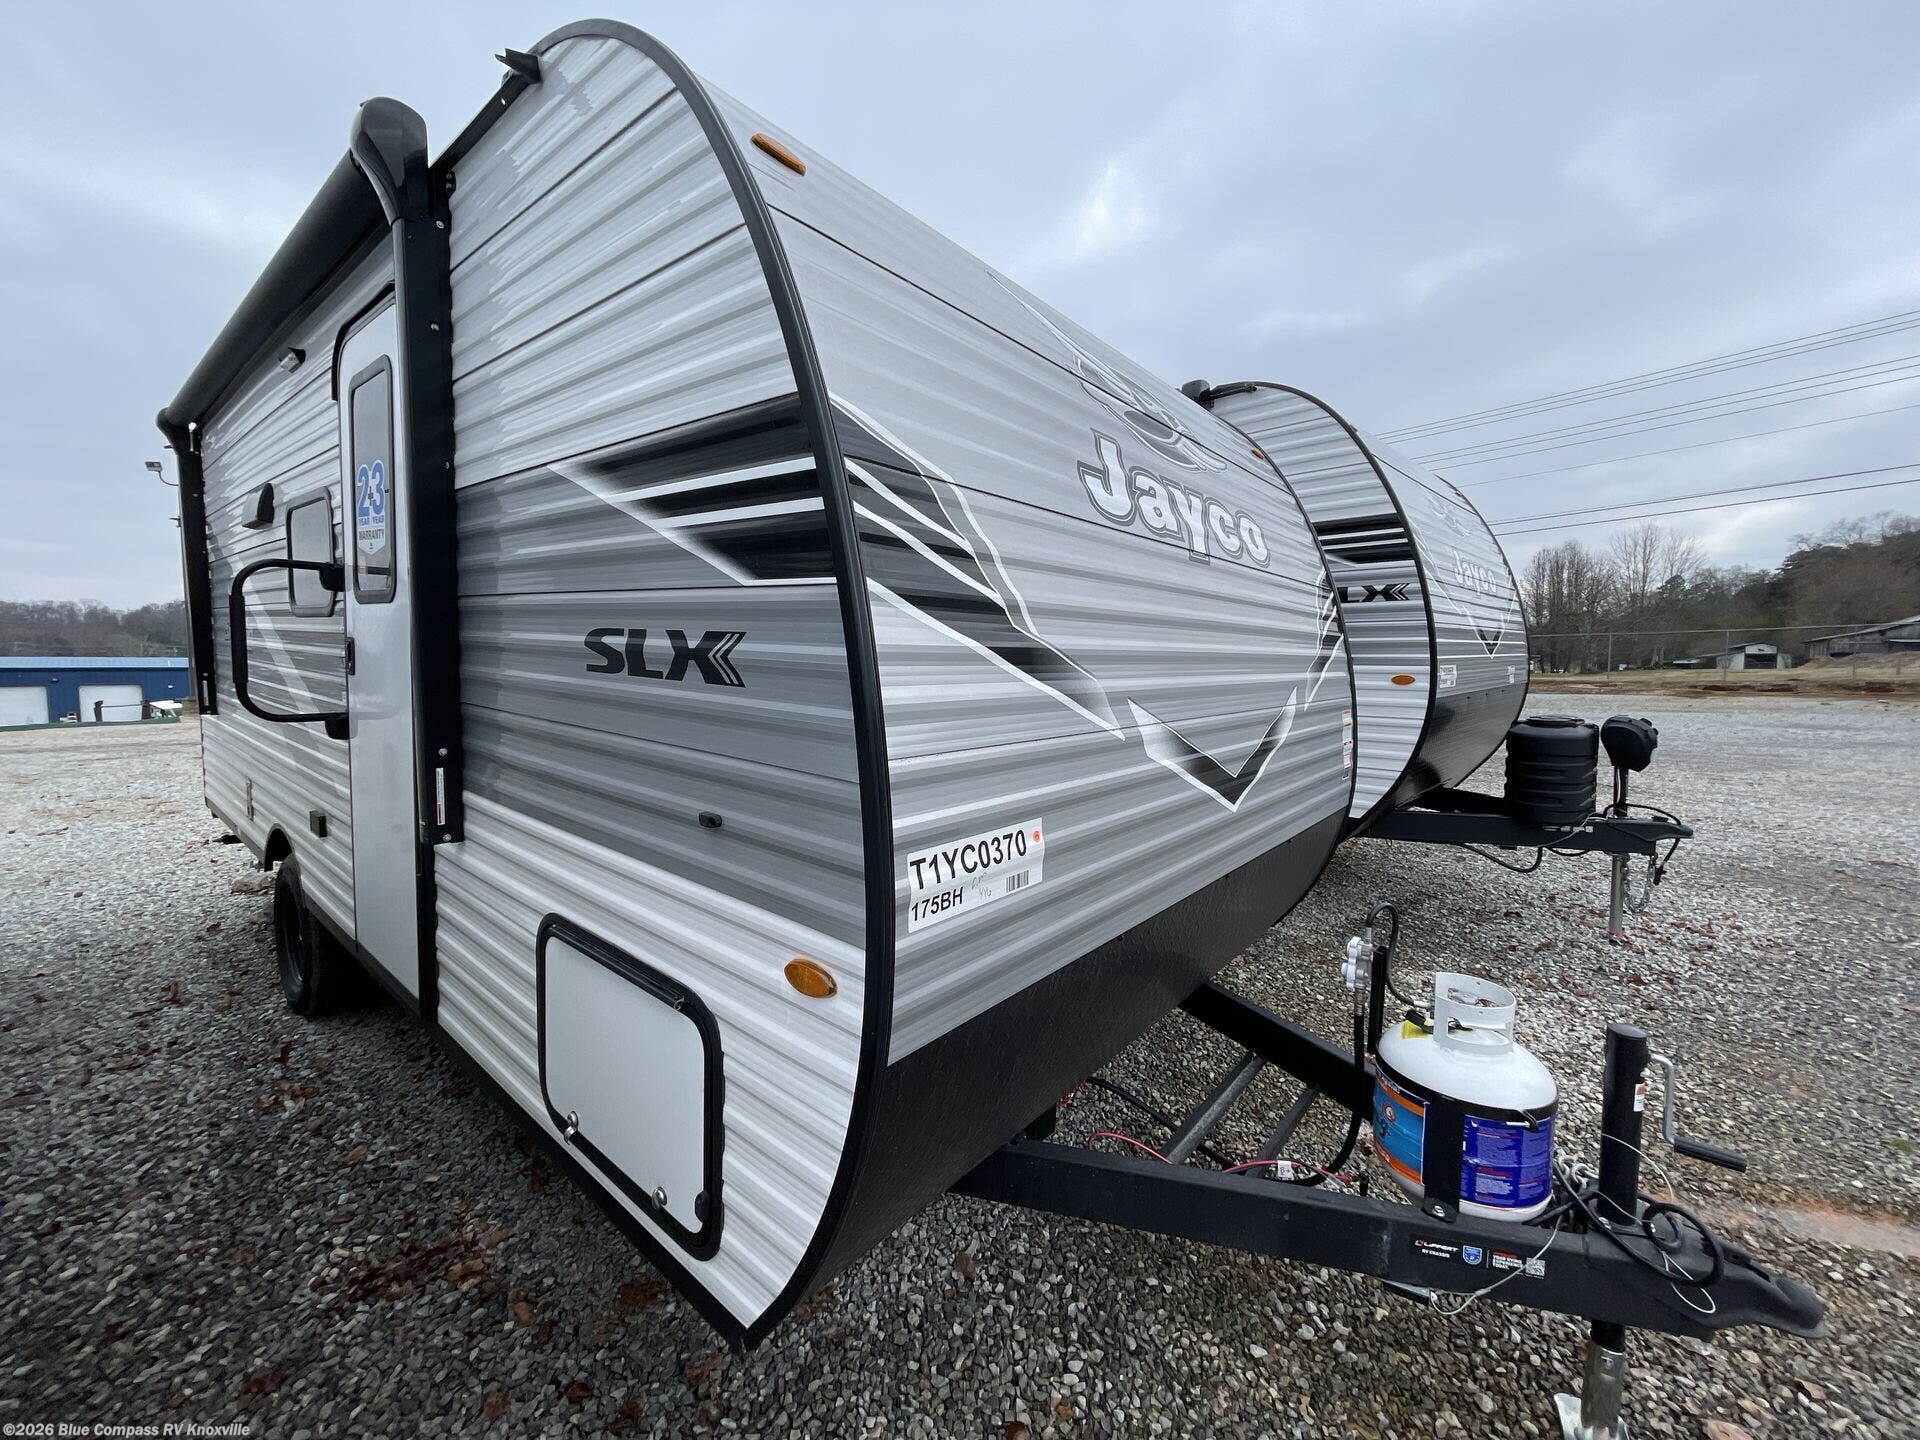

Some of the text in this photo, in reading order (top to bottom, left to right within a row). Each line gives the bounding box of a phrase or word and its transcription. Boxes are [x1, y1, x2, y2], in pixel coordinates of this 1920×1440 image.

[1077, 428, 1270, 565] Jayco
[358, 528, 385, 541] WARRANTY
[1452, 549, 1497, 597] Jayco
[584, 628, 747, 688] SLX
[910, 829, 1027, 890] T1YC0370
[911, 886, 964, 922] 175BH
